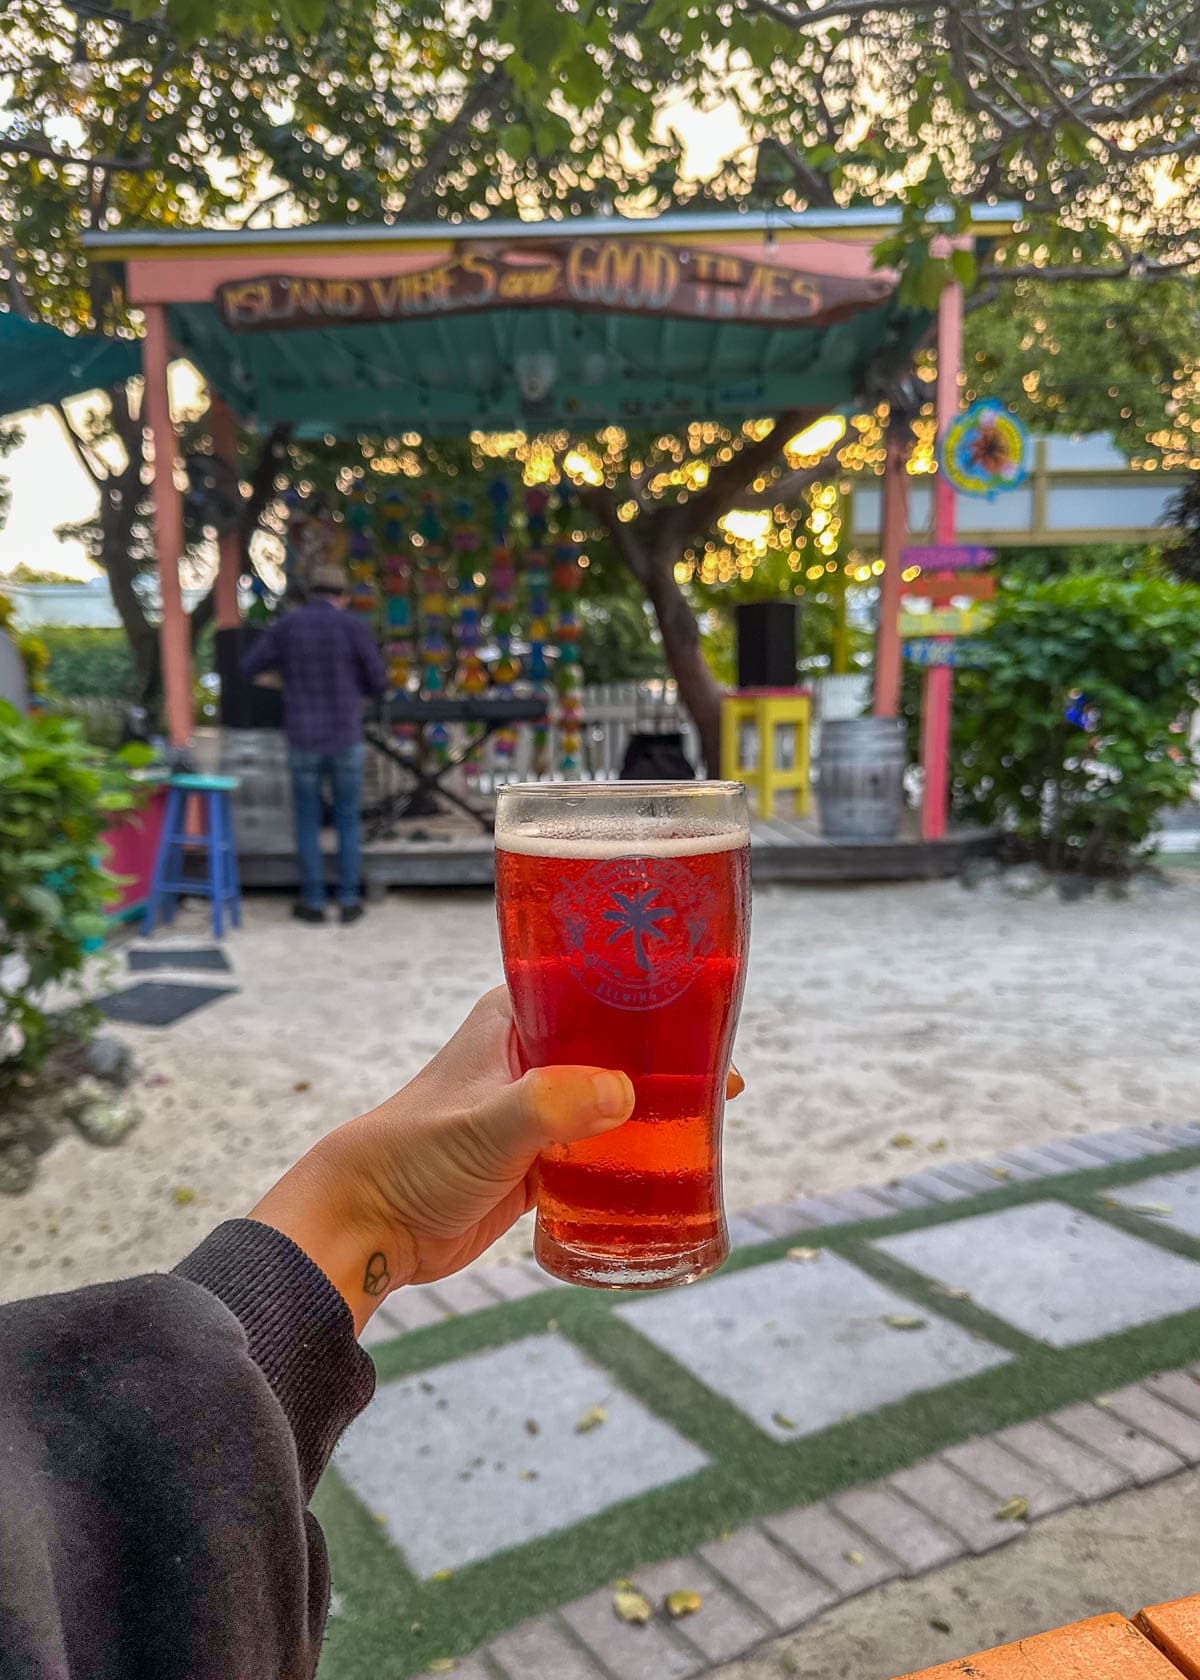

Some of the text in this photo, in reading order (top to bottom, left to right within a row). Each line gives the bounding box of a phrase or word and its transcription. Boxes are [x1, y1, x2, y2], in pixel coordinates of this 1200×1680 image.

[222, 279, 364, 322] ISLAND
[369, 253, 498, 318] VIBES
[566, 239, 680, 308] GOOD
[691, 251, 824, 319] TIMES
